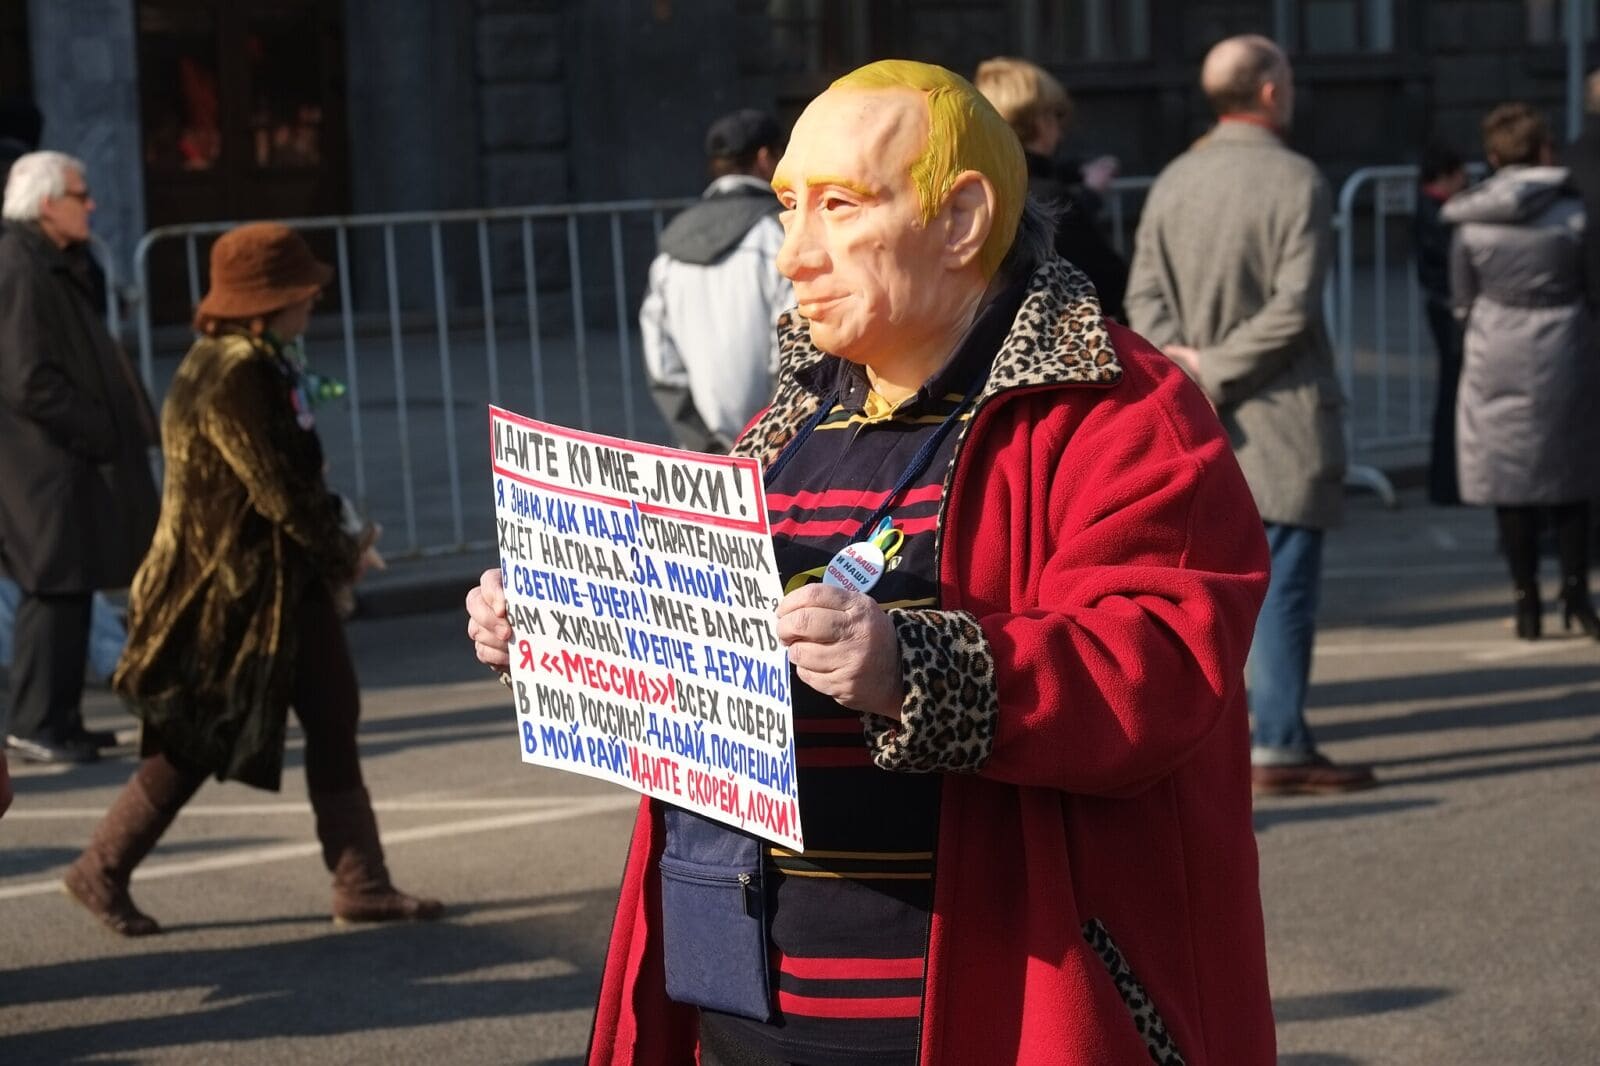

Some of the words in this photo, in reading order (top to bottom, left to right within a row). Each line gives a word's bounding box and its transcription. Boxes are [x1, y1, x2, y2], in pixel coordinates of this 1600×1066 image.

[494, 419, 559, 478] ИДИТЕ
[566, 441, 592, 488] КО
[497, 478, 506, 508] Я
[496, 517, 533, 561] ЖДЁТ
[836, 555, 844, 566] И
[843, 561, 870, 585] НАШУ
[845, 546, 856, 559] ЗА
[855, 554, 879, 576] ВАШУ
[501, 556, 508, 589] В
[649, 593, 700, 636] МНЕ
[701, 607, 779, 652] ВЛАСТЬ
[549, 609, 627, 659] ЖИЗНЬ!
[624, 626, 699, 677] КРЕПЧЕ
[703, 645, 791, 707] ДЕРЖИСЬ!
[516, 680, 531, 715] В
[535, 683, 576, 724] МОЮ
[578, 691, 647, 745] РОССИЮ!
[518, 639, 536, 673] Я
[675, 678, 722, 725] ВСЕХ
[726, 695, 787, 750] СОБЕРУ
[522, 720, 538, 754] В
[539, 720, 586, 763] МОЙ
[586, 735, 631, 779] РАЙ!
[628, 745, 682, 796] ИДИТЕ
